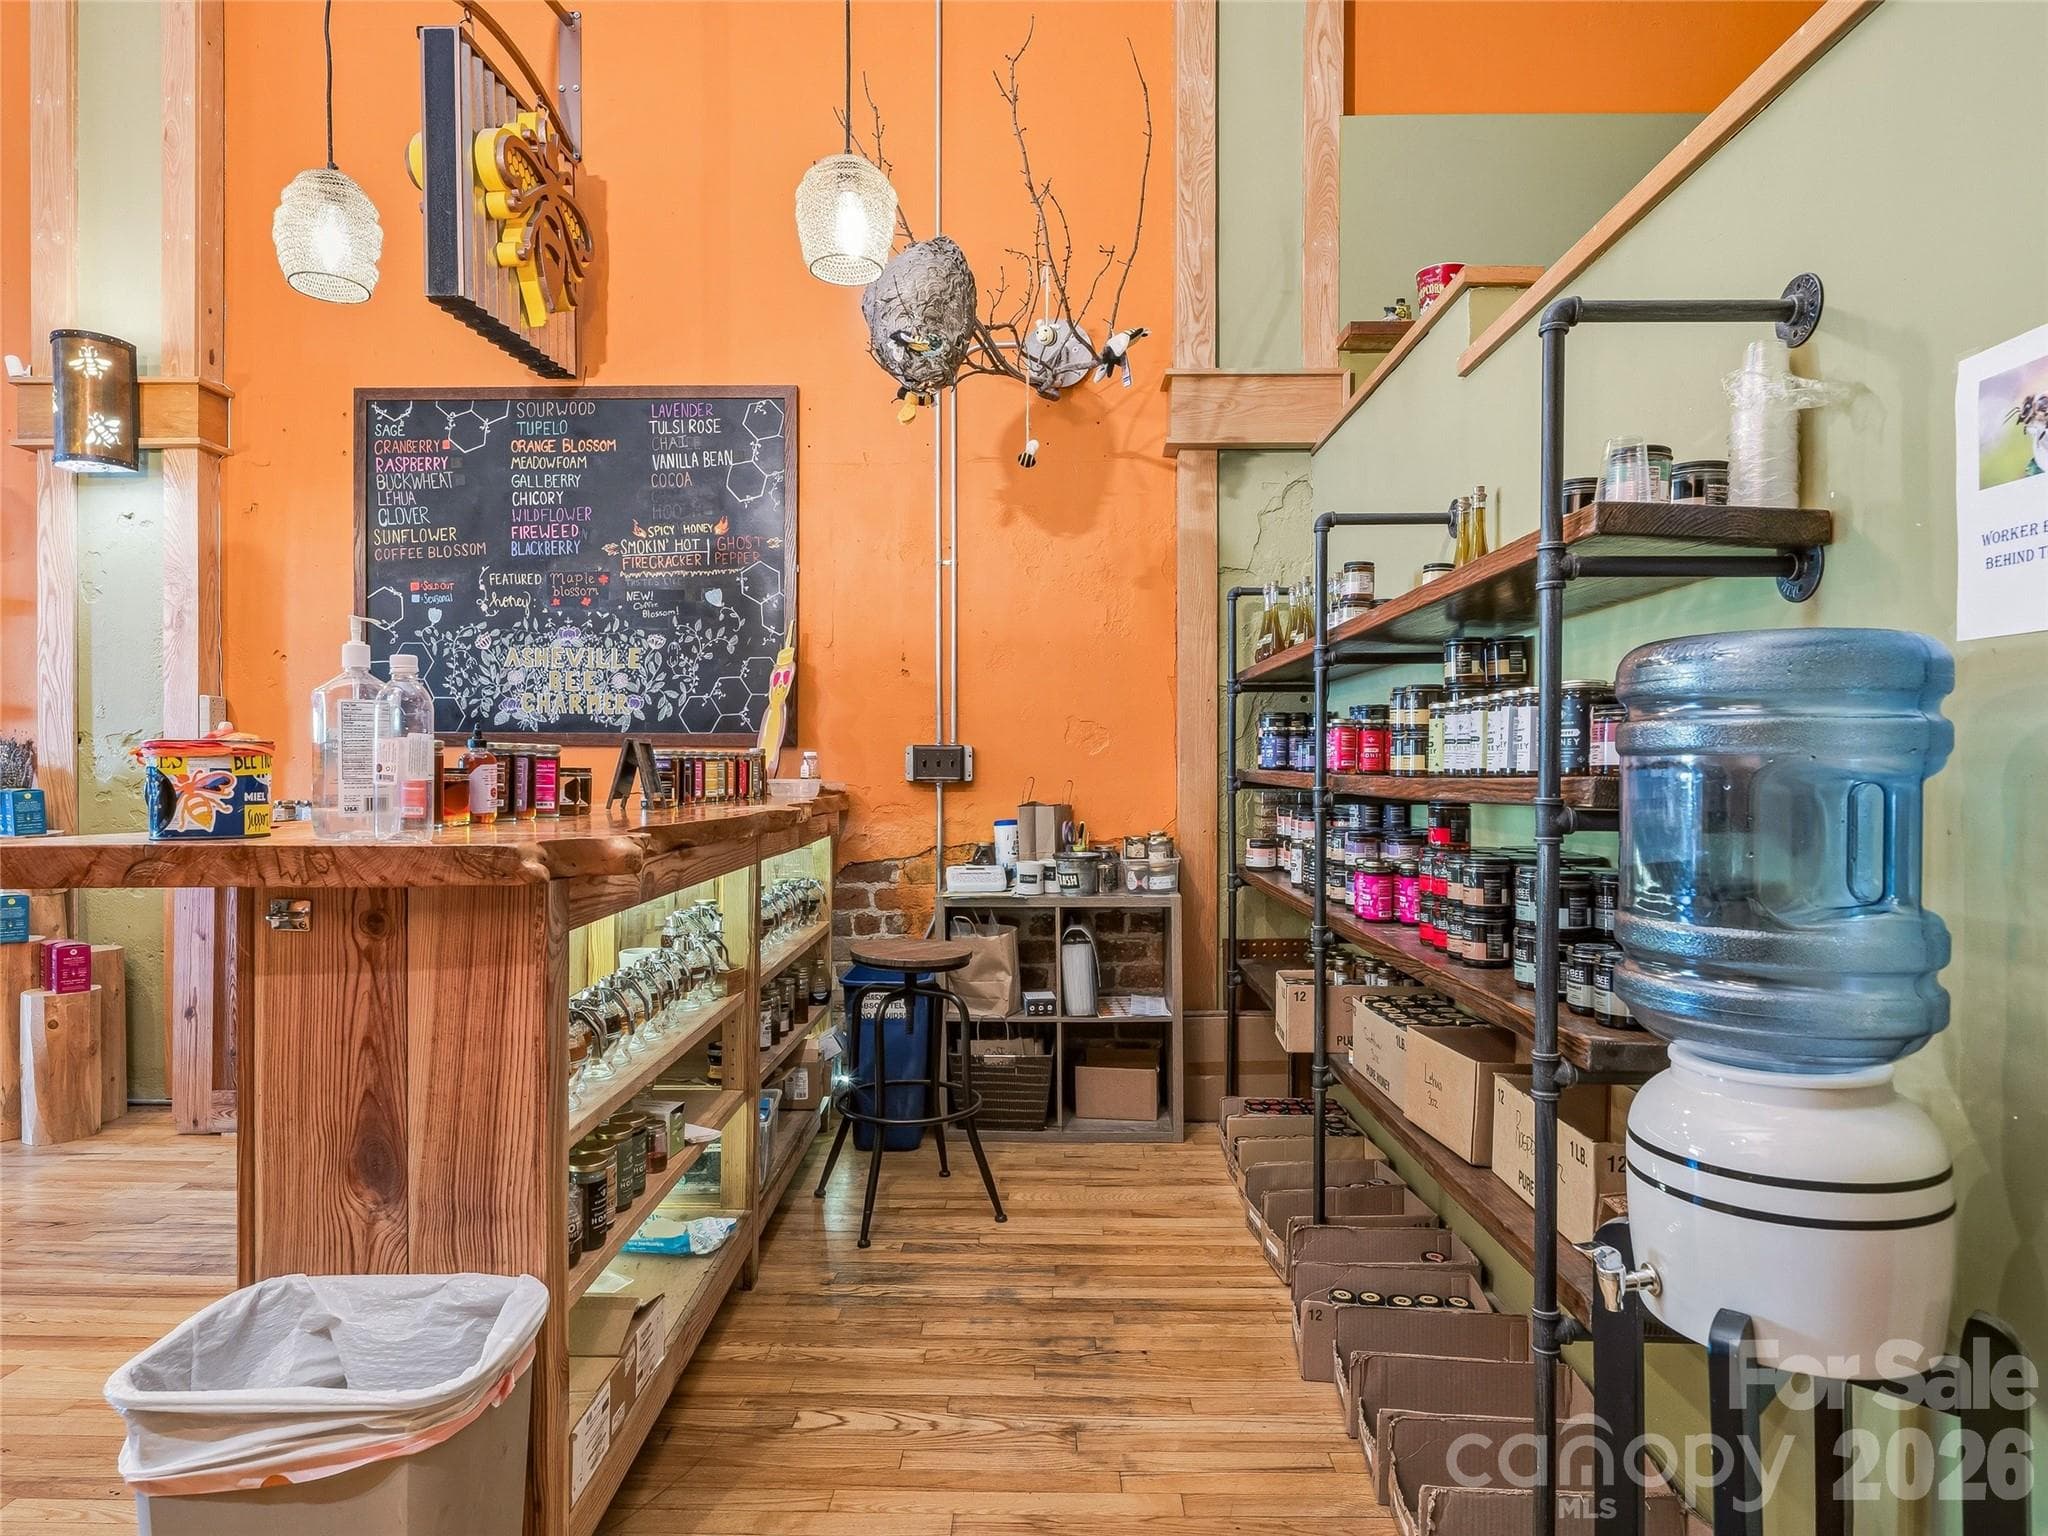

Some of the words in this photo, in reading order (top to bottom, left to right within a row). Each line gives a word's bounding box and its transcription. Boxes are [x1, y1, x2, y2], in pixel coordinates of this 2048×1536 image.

[516, 401, 596, 418] SOURWOOD
[651, 402, 714, 418] LAVENDER
[374, 423, 405, 437] SAGE
[516, 420, 568, 435] TUPELO
[648, 419, 684, 434] TULSI
[688, 418, 721, 434] ROSE
[374, 439, 440, 455] CRANBERRY
[511, 439, 556, 453] ORANGE
[562, 437, 617, 453] BLOSSOM
[376, 456, 448, 473] RASPBERRY
[510, 455, 587, 470] MEADOWFOAM
[652, 454, 699, 470] VANILLA
[703, 449, 733, 468] BEAN
[376, 471, 453, 490] BUCKWHEAT
[511, 474, 581, 488] GALLBERRY
[651, 471, 693, 488] COCOA
[377, 490, 417, 507] LEHUA
[512, 490, 564, 506] CHICORY
[378, 506, 431, 527] CLOVER
[511, 506, 592, 522] WILDFLOWER
[374, 527, 457, 545] SUNFLOWER
[511, 523, 579, 539] FIREWEED
[648, 525, 675, 537] SPICY
[683, 523, 714, 535] HONEY
[1981, 522, 2038, 546] WORKER
[511, 540, 581, 556] BLACKBERRY
[675, 538, 701, 552] HOT
[716, 536, 764, 551] GHOST
[374, 547, 424, 562] COFFEE
[428, 542, 487, 560] BLOSSOM
[714, 551, 762, 565] PEPPER
[1985, 549, 2035, 570] BEHIND
[622, 554, 702, 570] FIRECRACKER
[489, 572, 542, 586] FEATURED
[626, 590, 654, 602] NEW!
[503, 646, 642, 669] ASHEVILLE
[548, 669, 598, 692] BEE
[521, 692, 633, 715] CHARMER
[244, 792, 266, 802] MIEL
[1294, 991, 1306, 1002] 12
[1497, 1088, 1505, 1105] 12
[1607, 1155, 1626, 1173] 12
[1518, 1170, 1534, 1197] PURE
[1308, 1309, 1323, 1321] 12
